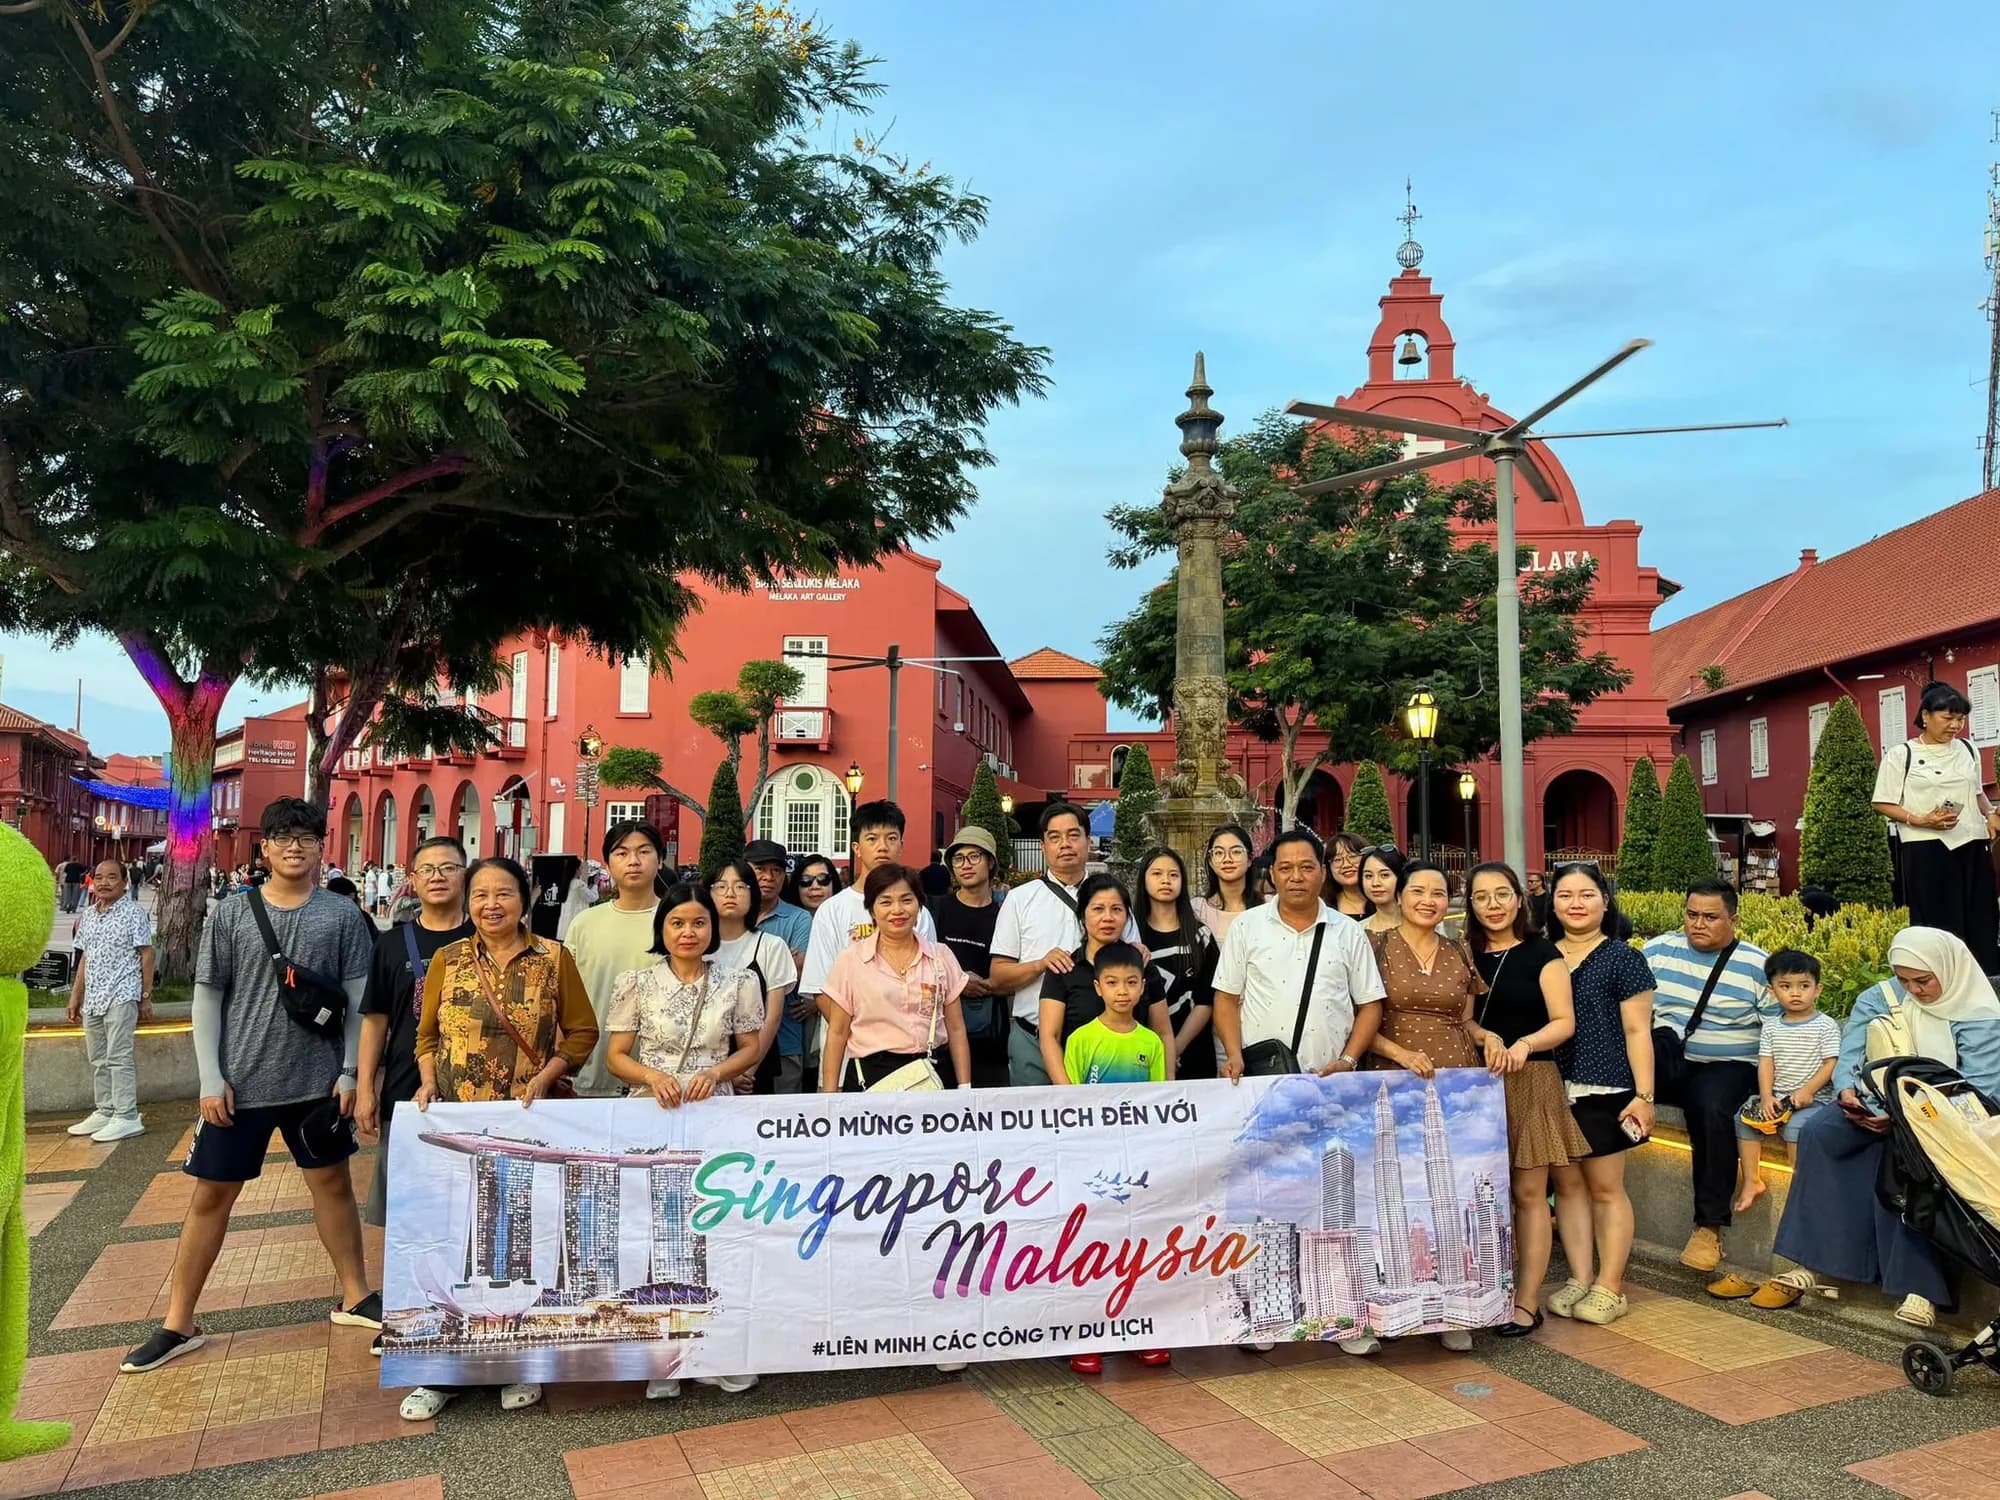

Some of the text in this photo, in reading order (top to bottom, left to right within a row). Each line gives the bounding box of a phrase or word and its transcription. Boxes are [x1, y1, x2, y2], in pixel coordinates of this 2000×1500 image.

[768, 592, 846, 601] MELAKA ART GALLERY
[824, 578, 860, 589] MELAKA
[757, 1098, 1198, 1139] CHÀO MỪNG ĐOÀN DU LỊCH ĐẾN VỚI
[691, 1151, 1053, 1261] Singapore
[921, 1202, 1261, 1319] Malaysia
[812, 1317, 1153, 1356] #LIÊN MINH CÁC CÔNG TY DU LỊCH
